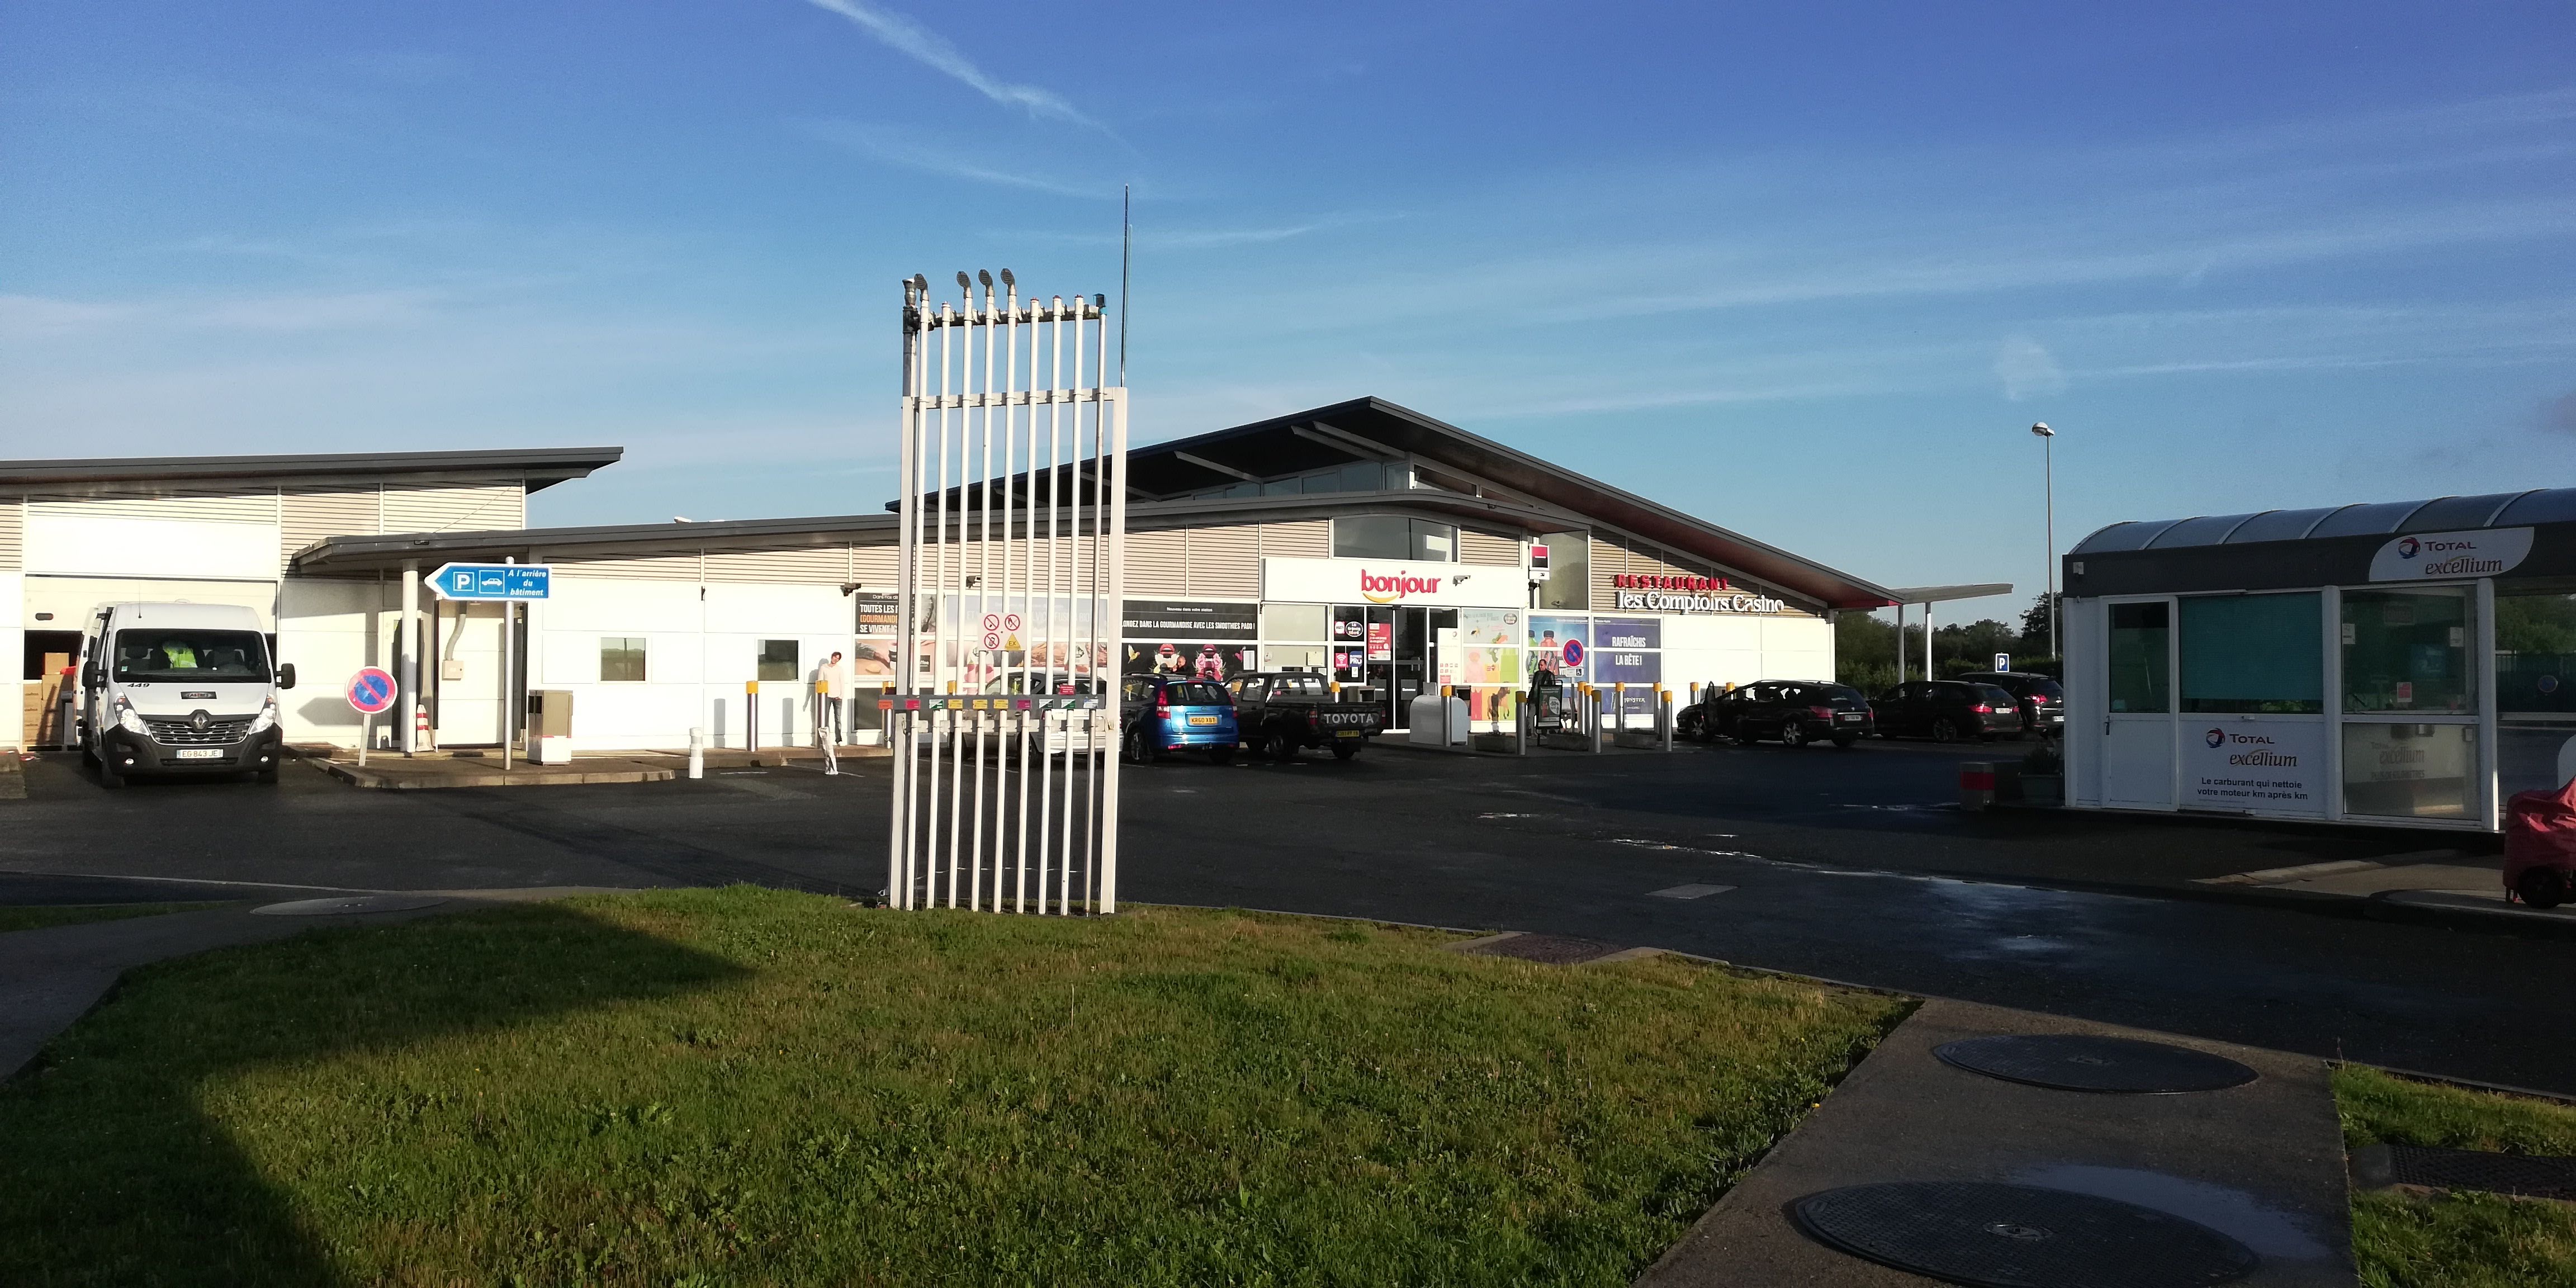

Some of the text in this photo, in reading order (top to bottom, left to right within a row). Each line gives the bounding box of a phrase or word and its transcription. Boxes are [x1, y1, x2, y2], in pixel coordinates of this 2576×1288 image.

[2425, 541, 2476, 551] TOTAL
[2426, 557, 2502, 575] excellium
[457, 574, 470, 589] P
[1362, 569, 1441, 598] bonjour
[1616, 574, 1728, 590] RESTAURANT
[860, 604, 883, 613] TOUTES
[883, 605, 894, 613] LES
[1617, 590, 1785, 615] les Comptoirs Casino
[860, 624, 868, 633] SE
[869, 624, 890, 633] VIVENT
[1612, 635, 1646, 647] RAFRAÎCHIS
[1615, 655, 1623, 665] LA
[1625, 653, 1639, 665] BÊTE
[1999, 657, 2006, 669] P
[1324, 713, 1374, 724] TOYOTA
[2229, 733, 2275, 744] TOTAL
[2230, 752, 2298, 767] excellium
[2214, 778, 2253, 787] carburant
[2256, 779, 2270, 789] qui
[2272, 780, 2302, 789] nettoie
[2252, 790, 2265, 798] km
[2267, 790, 2291, 800] après
[2294, 792, 2308, 800] km
